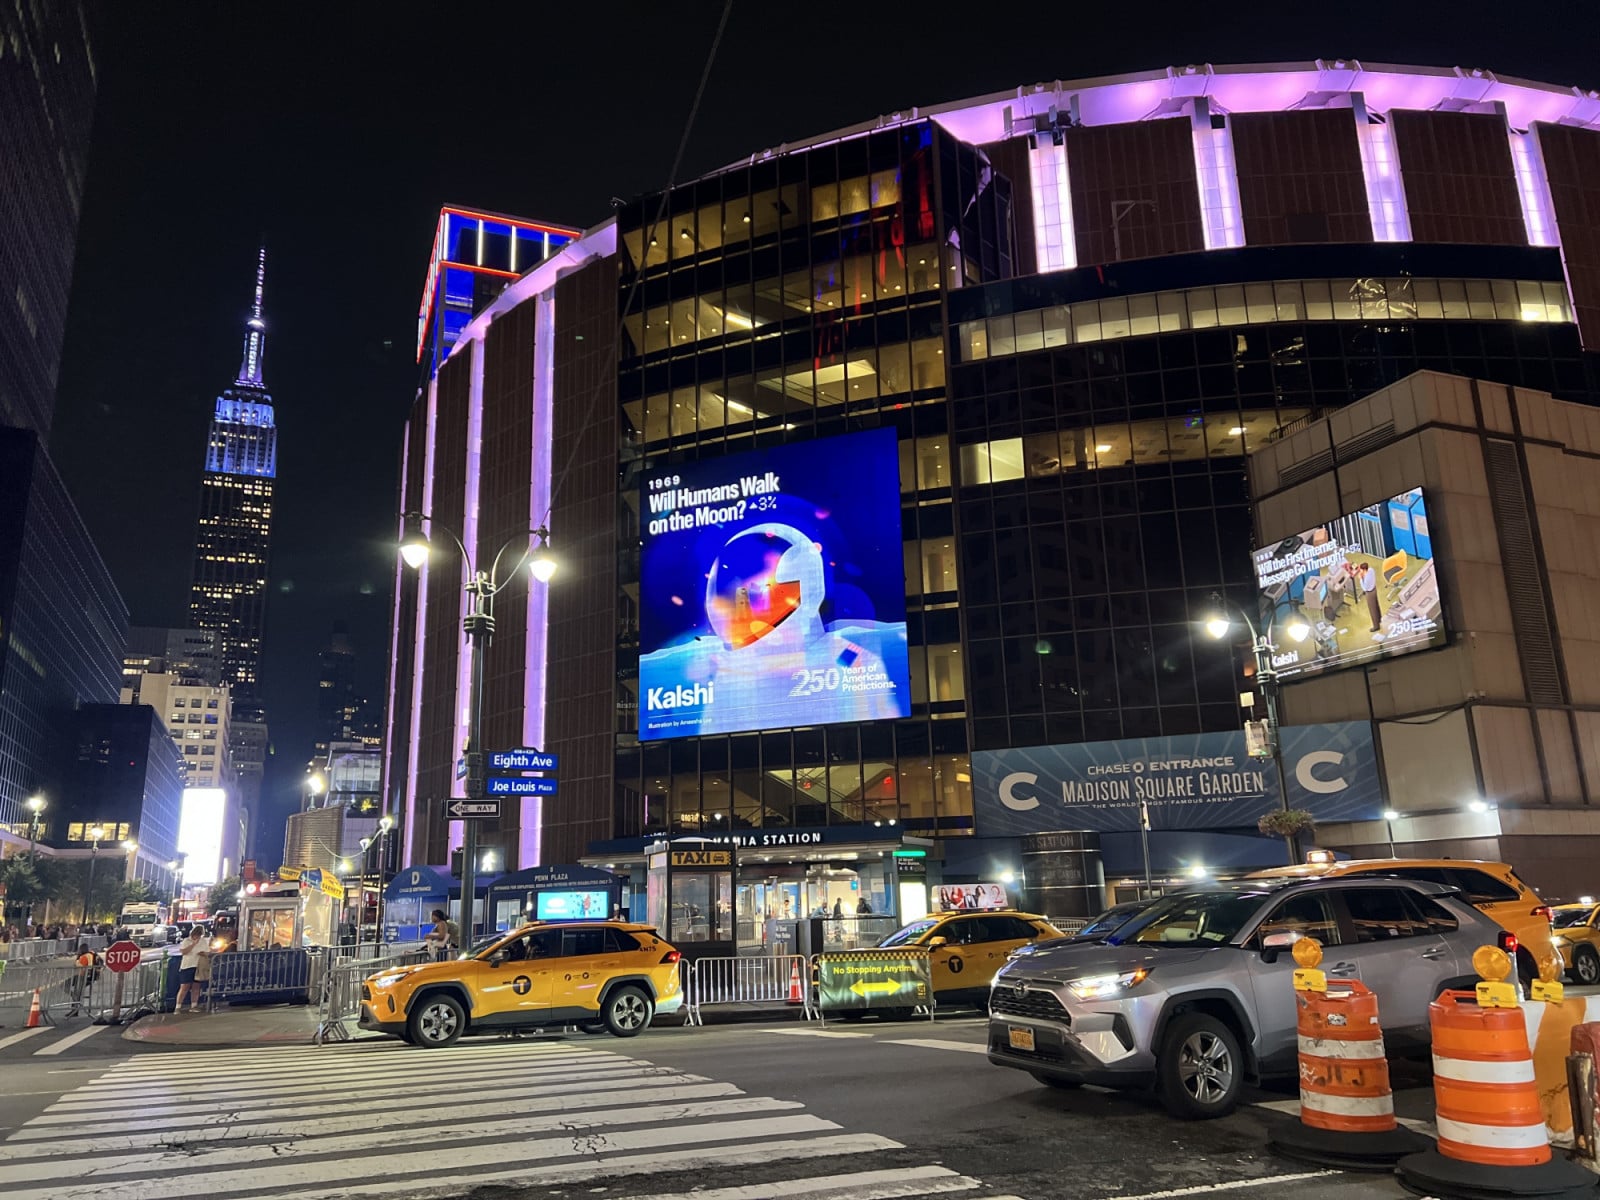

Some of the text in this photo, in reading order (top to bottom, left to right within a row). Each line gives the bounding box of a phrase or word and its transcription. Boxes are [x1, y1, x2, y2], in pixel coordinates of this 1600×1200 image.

[648, 475, 681, 490] 1969
[649, 472, 780, 513] Will Humans Walk
[649, 495, 777, 535] on the Moon? 3%
[1257, 538, 1338, 575] Will the First Internet
[1259, 569, 1297, 589] Message
[1294, 563, 1308, 578] Go
[1306, 546, 1346, 571] Through?
[1386, 620, 1412, 640] 250
[841, 662, 878, 675] Years of
[787, 668, 840, 697] 250
[841, 673, 888, 684] American
[842, 681, 897, 692] Predictions.
[647, 681, 714, 711] Kalshi
[493, 754, 553, 768] Eighth Ave
[1087, 756, 1235, 775] CHASE ENTRANCE
[492, 781, 509, 792] Joe
[511, 781, 536, 792] Louis
[998, 771, 1040, 811] C
[1061, 780, 1130, 803] MADISON
[455, 804, 470, 812] ONE
[763, 832, 822, 850] STATION
[674, 852, 711, 864] TAXI
[411, 871, 421, 886] D
[550, 873, 569, 881] PLAZA
[107, 950, 139, 964] STOP
[847, 966, 881, 975] Stopping
[883, 963, 917, 974] Anytime
